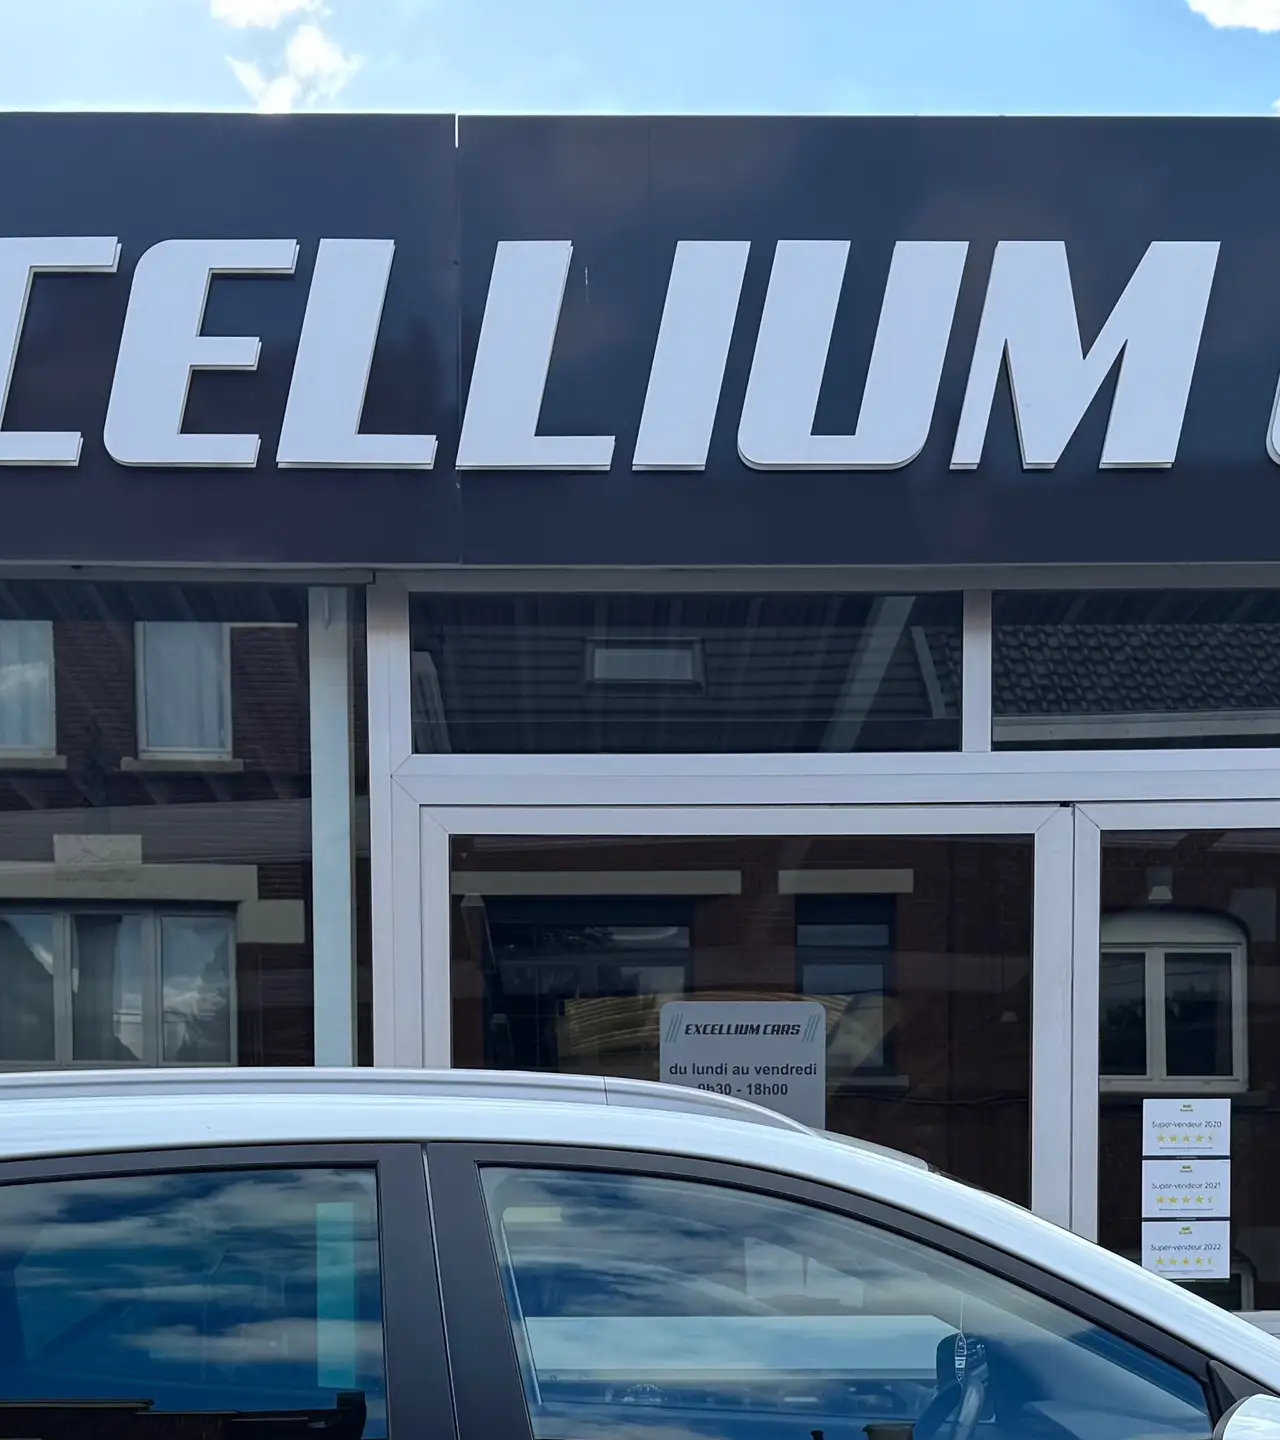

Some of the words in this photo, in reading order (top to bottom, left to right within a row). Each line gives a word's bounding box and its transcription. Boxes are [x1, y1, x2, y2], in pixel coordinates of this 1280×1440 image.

[684, 1024, 761, 1036] EXCELLIUM
[762, 1024, 801, 1036] CARS
[669, 1063, 688, 1076] du
[692, 1063, 728, 1076] lundi
[732, 1065, 750, 1076] au
[754, 1063, 817, 1076] vendredi
[746, 1083, 788, 1096] 18h00
[1204, 1243, 1222, 1251] 2022
